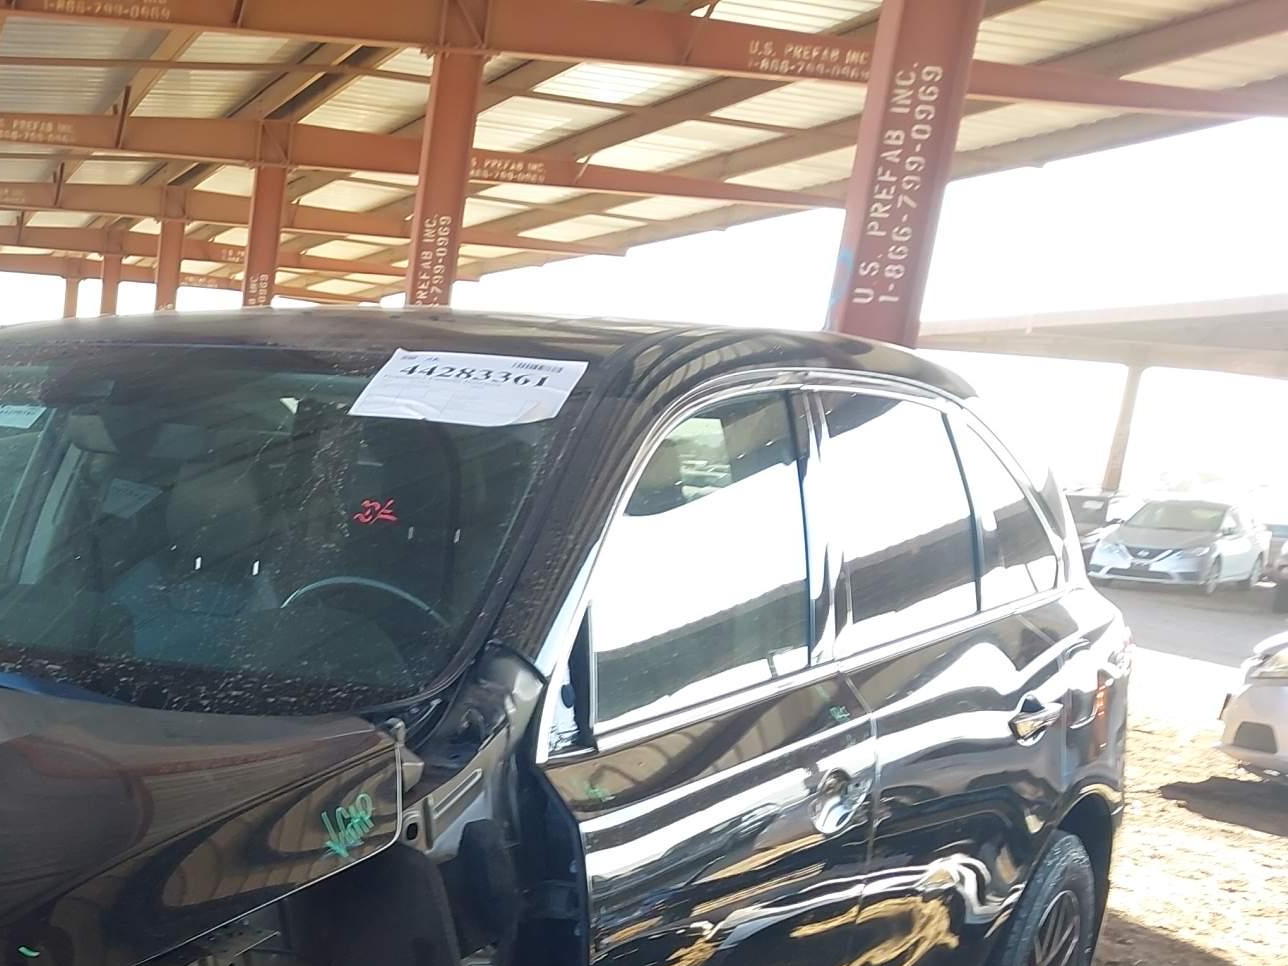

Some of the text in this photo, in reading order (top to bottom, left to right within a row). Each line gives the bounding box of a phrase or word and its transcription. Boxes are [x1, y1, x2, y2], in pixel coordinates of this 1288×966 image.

[783, 43, 841, 61] PREFAB
[866, 128, 906, 236] PREFAB
[890, 62, 920, 114] INC.
[878, 65, 944, 302] 1-866-799-0969
[400, 364, 550, 388] 44283361
